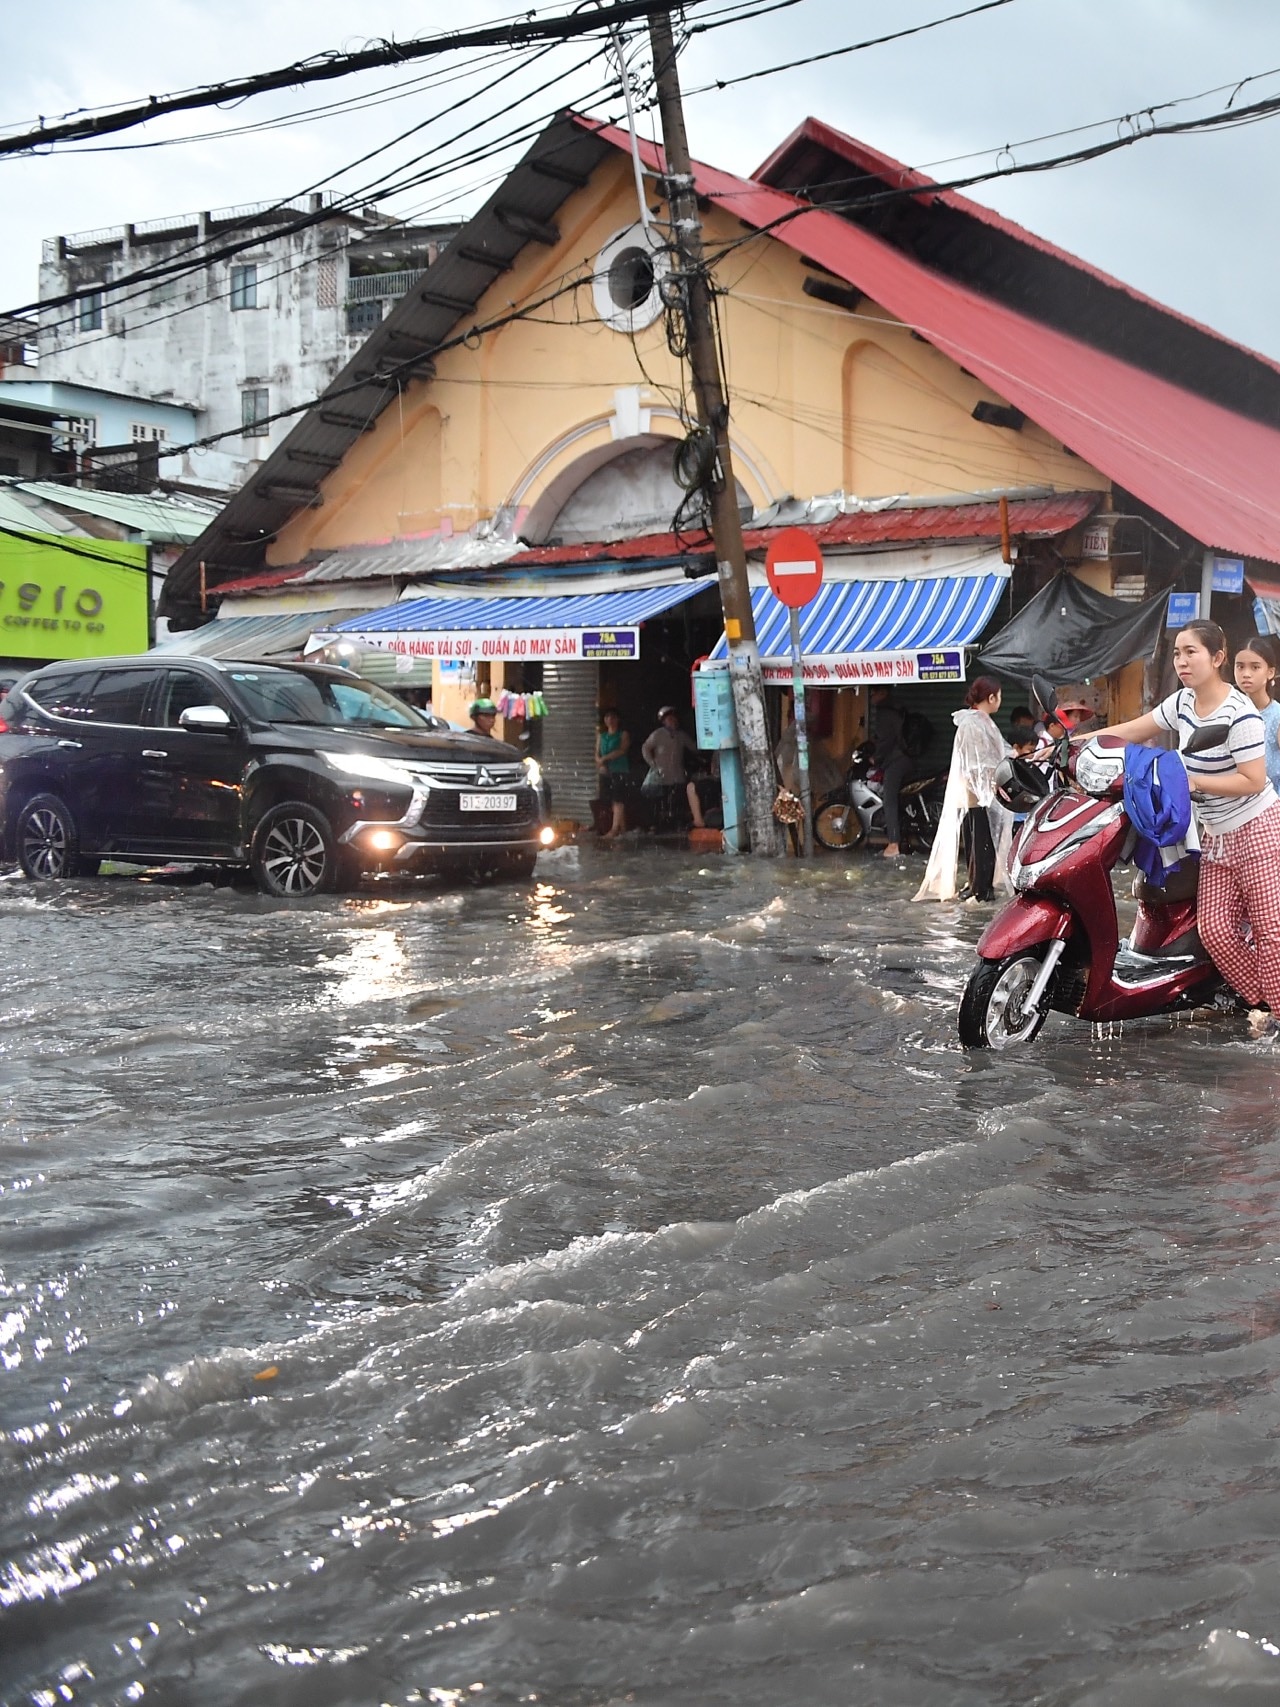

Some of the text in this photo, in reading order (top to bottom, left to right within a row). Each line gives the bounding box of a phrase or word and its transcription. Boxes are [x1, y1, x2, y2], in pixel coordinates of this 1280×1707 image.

[4, 615, 104, 633] COFFEE TO GO
[530, 638, 551, 655] MAY
[874, 660, 893, 677] MAY
